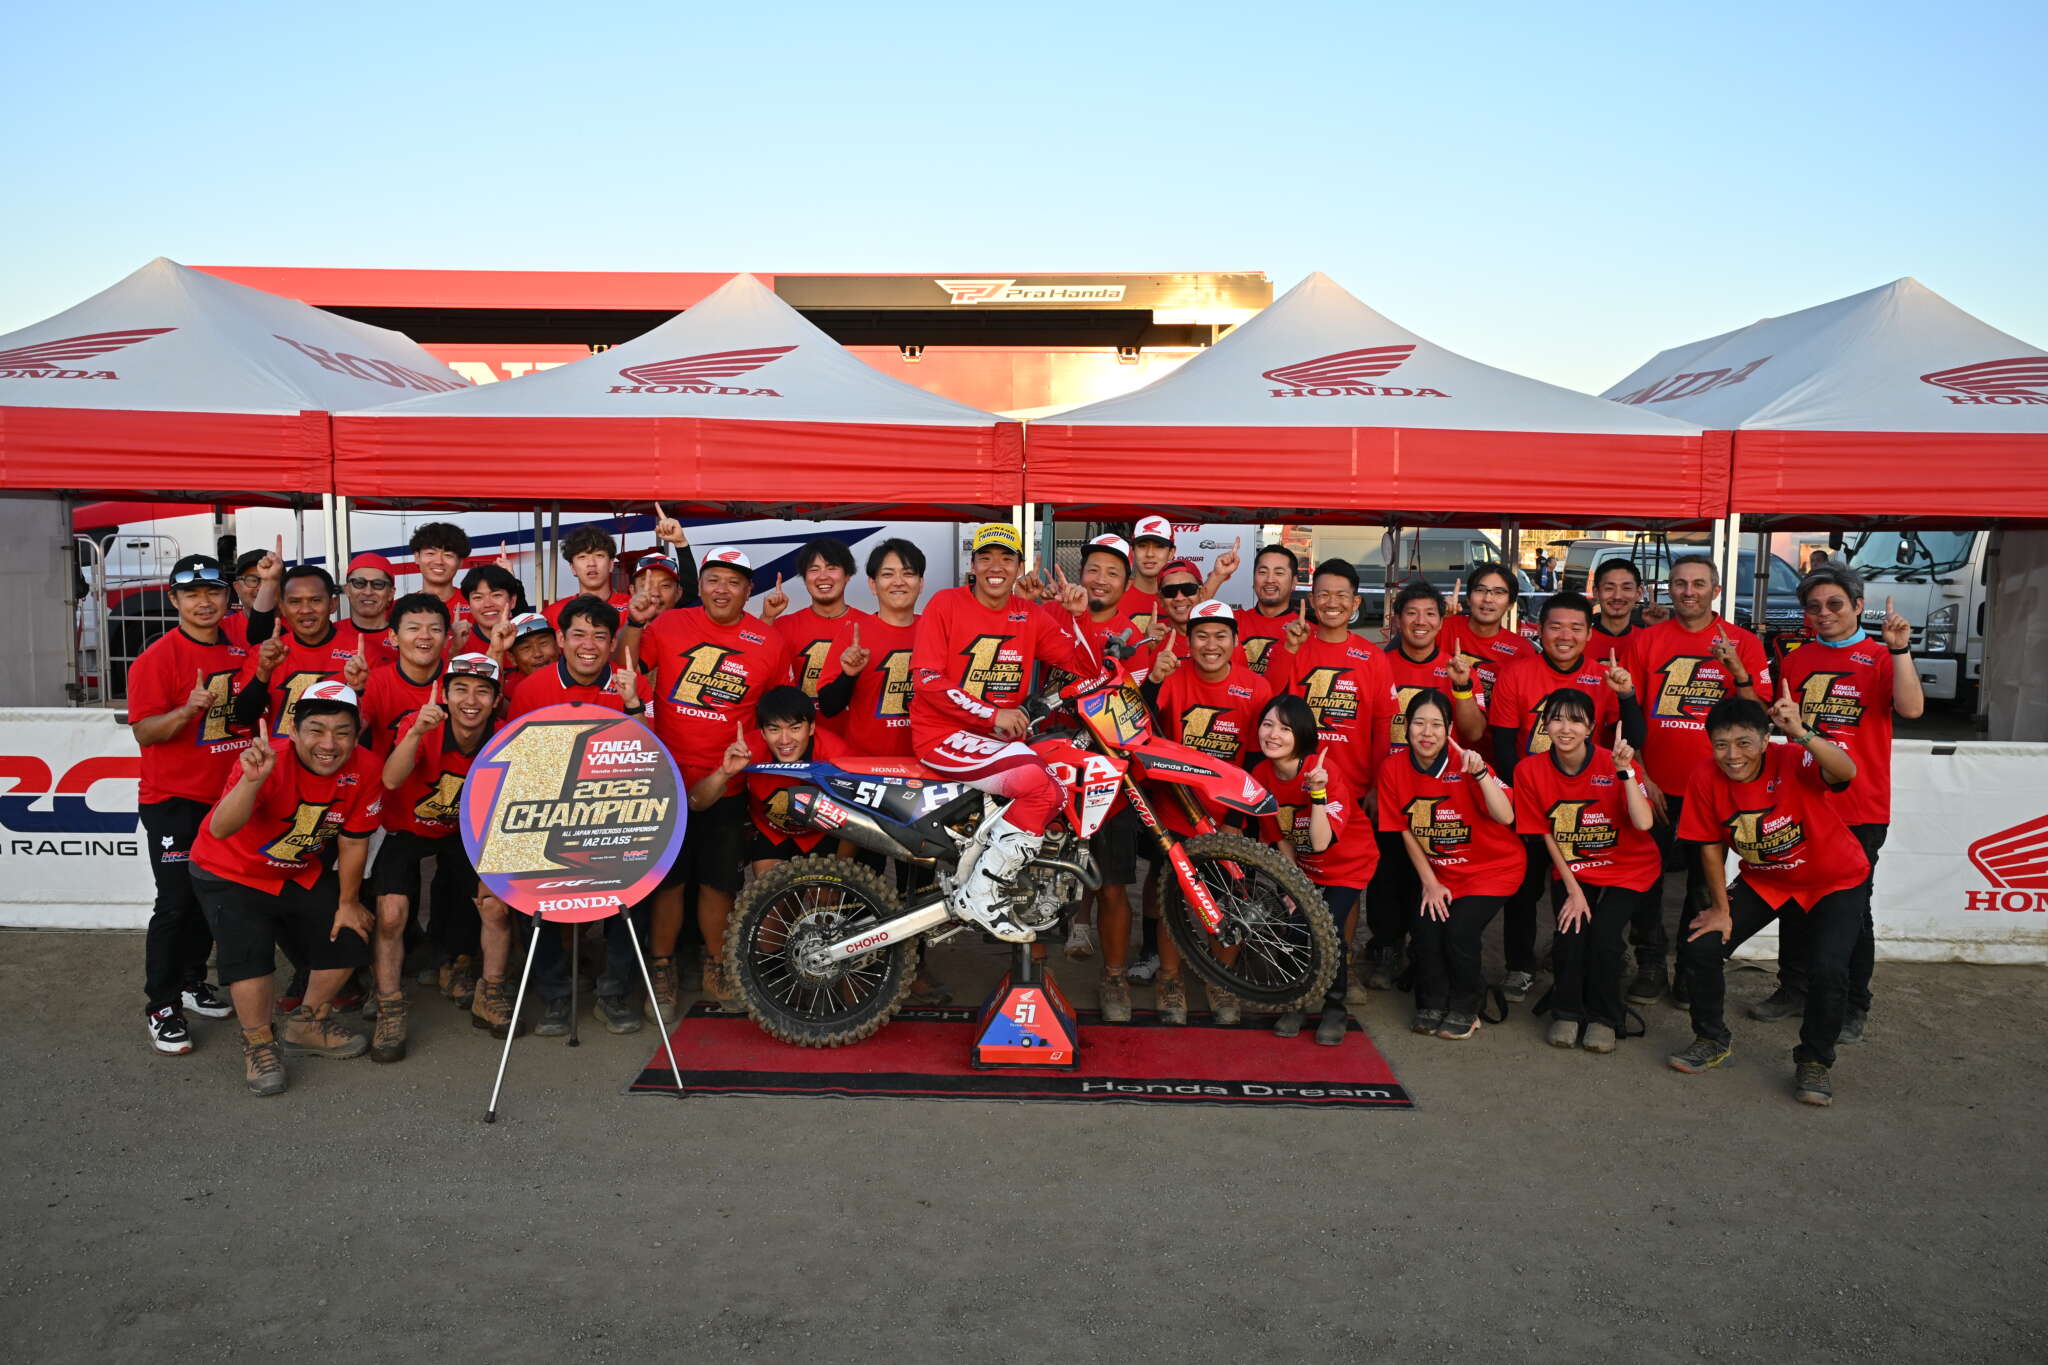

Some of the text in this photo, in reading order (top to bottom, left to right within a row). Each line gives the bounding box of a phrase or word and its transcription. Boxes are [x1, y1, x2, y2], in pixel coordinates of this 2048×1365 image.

[605, 384, 785, 398] HONDA
[1268, 386, 1453, 399] HONDA
[1864, 609, 1887, 620] ISUZ
[970, 671, 1023, 682] CHAMPION
[687, 673, 747, 695] CHAMPION
[1666, 685, 1725, 698] CHAMPION
[1309, 698, 1358, 710] CHAMPION
[1804, 703, 1862, 717] CHAMPION
[676, 706, 728, 722] HONDA
[886, 719, 912, 728] HON
[590, 739, 642, 753] TAIGA
[1184, 735, 1240, 752] CHAMPION
[587, 751, 660, 766] YANASE
[1153, 761, 1212, 775] Honda Dream
[572, 778, 652, 799] 2026
[853, 781, 888, 809] 51
[1086, 782, 1116, 796] HRC
[504, 797, 671, 831] CHAMPION
[1414, 827, 1469, 837] CHAMPION
[1556, 830, 1617, 842] CHAMPION
[600, 835, 632, 846] CLASS
[11, 840, 138, 856] RACING
[266, 860, 309, 869] HON
[1570, 860, 1614, 872] ONDA
[537, 895, 623, 912] HONDA
[845, 931, 889, 954] CHOHO
[1014, 1003, 1036, 1024] 51
[1081, 1081, 1391, 1098] Honda Dream
